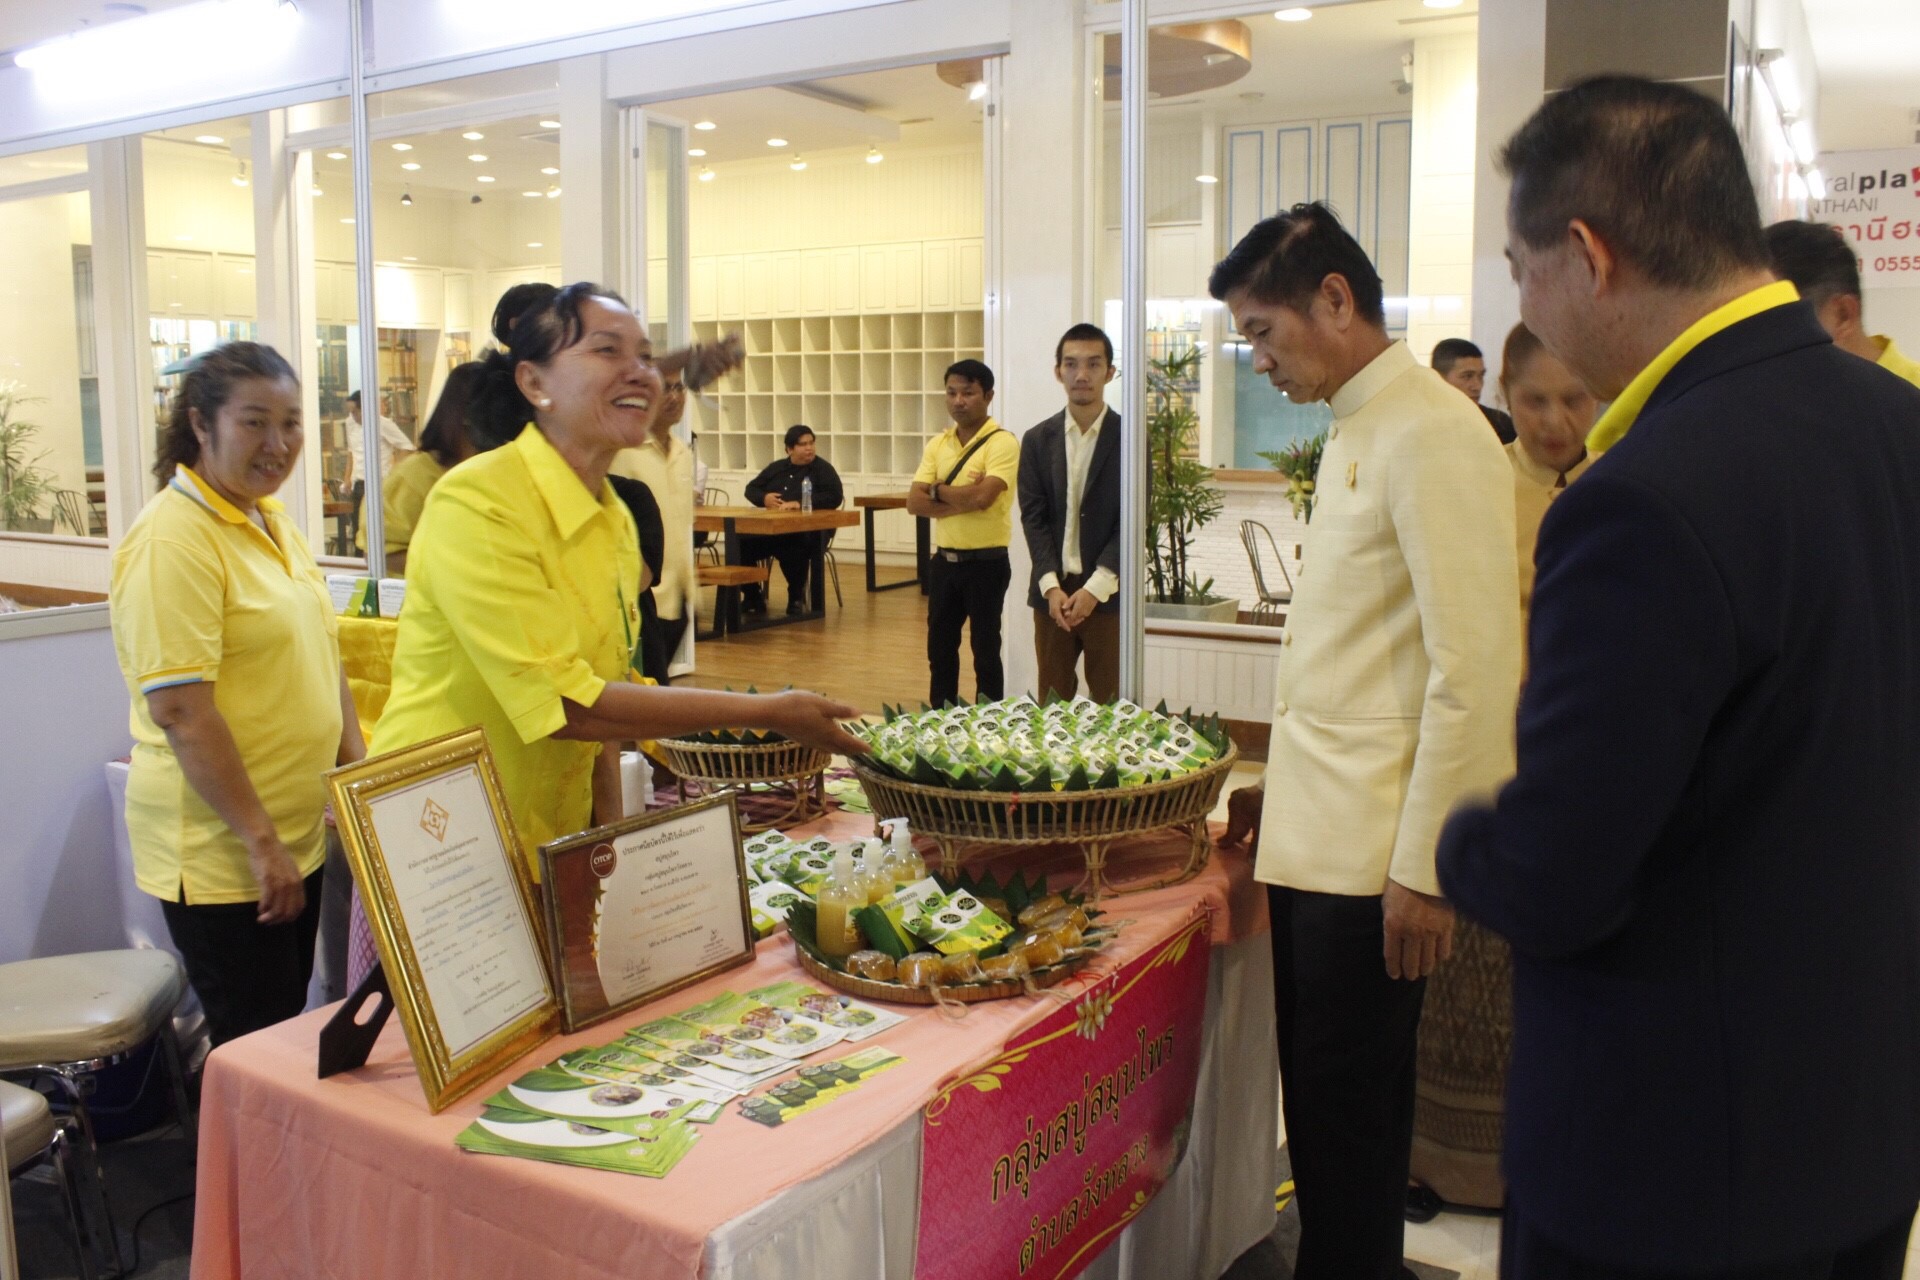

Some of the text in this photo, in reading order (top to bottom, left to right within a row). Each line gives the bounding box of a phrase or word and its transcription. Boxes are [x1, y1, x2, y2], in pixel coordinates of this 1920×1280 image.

[593, 853, 613, 865] OTOP
[992, 1025, 1175, 1203] กลุ่มสบู่สมุนไพร
[1019, 1134, 1149, 1276] ตำบลวังหลวง
